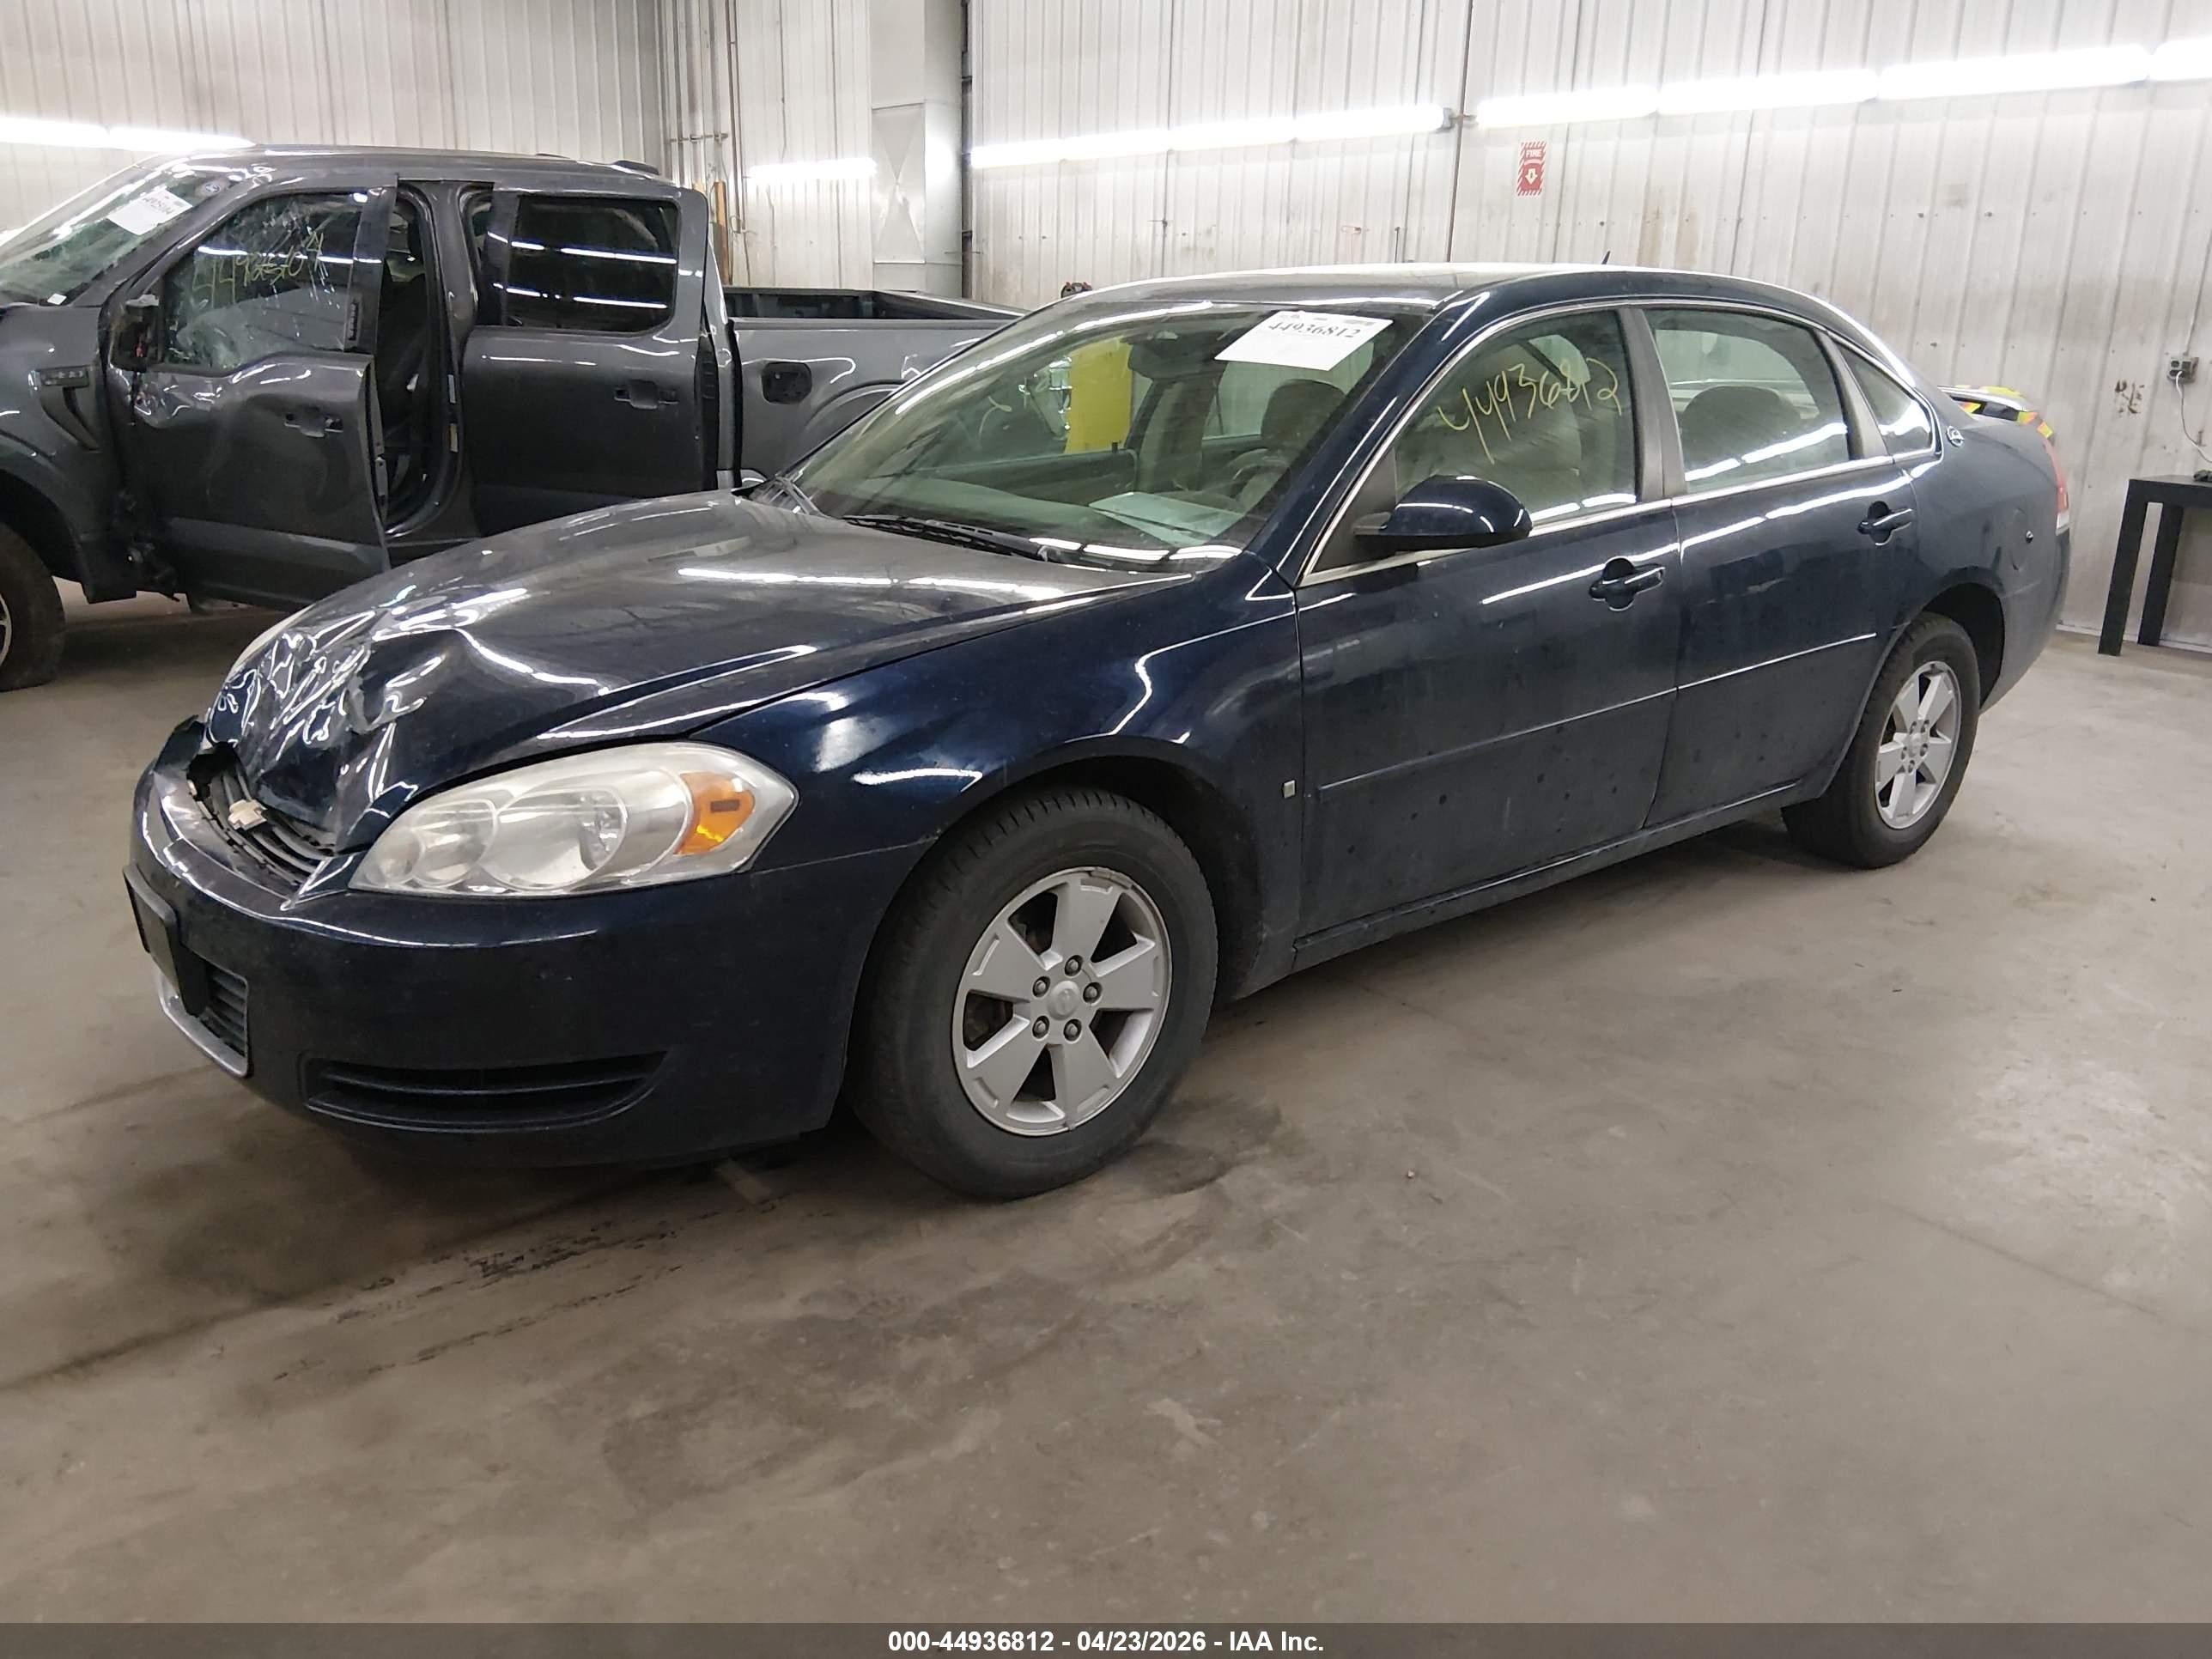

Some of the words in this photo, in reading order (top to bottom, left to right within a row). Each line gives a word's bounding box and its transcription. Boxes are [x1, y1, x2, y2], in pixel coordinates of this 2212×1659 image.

[1525, 149, 1543, 159] FIRE
[1267, 320, 1362, 339] 44936812
[1437, 356, 1623, 465] 44936812
